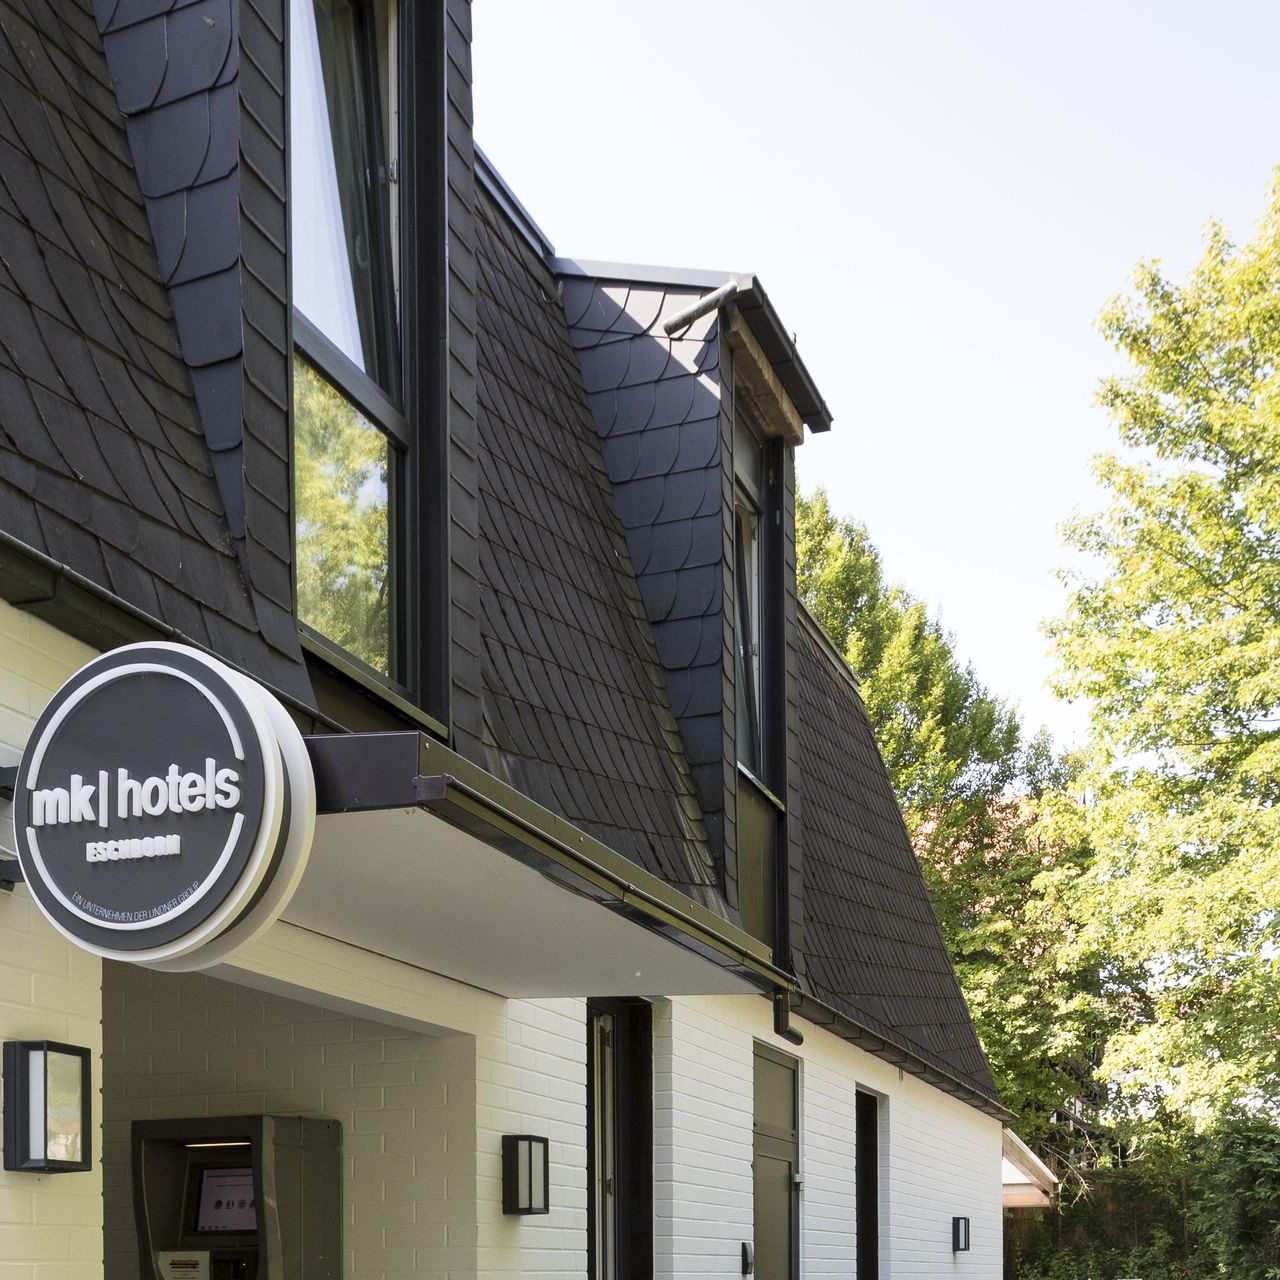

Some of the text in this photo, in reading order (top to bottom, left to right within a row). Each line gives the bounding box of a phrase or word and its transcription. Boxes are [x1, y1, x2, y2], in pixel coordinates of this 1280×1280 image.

[72, 881, 199, 922] EIN UNTERNEHMEN DER LINDNER GROUP
